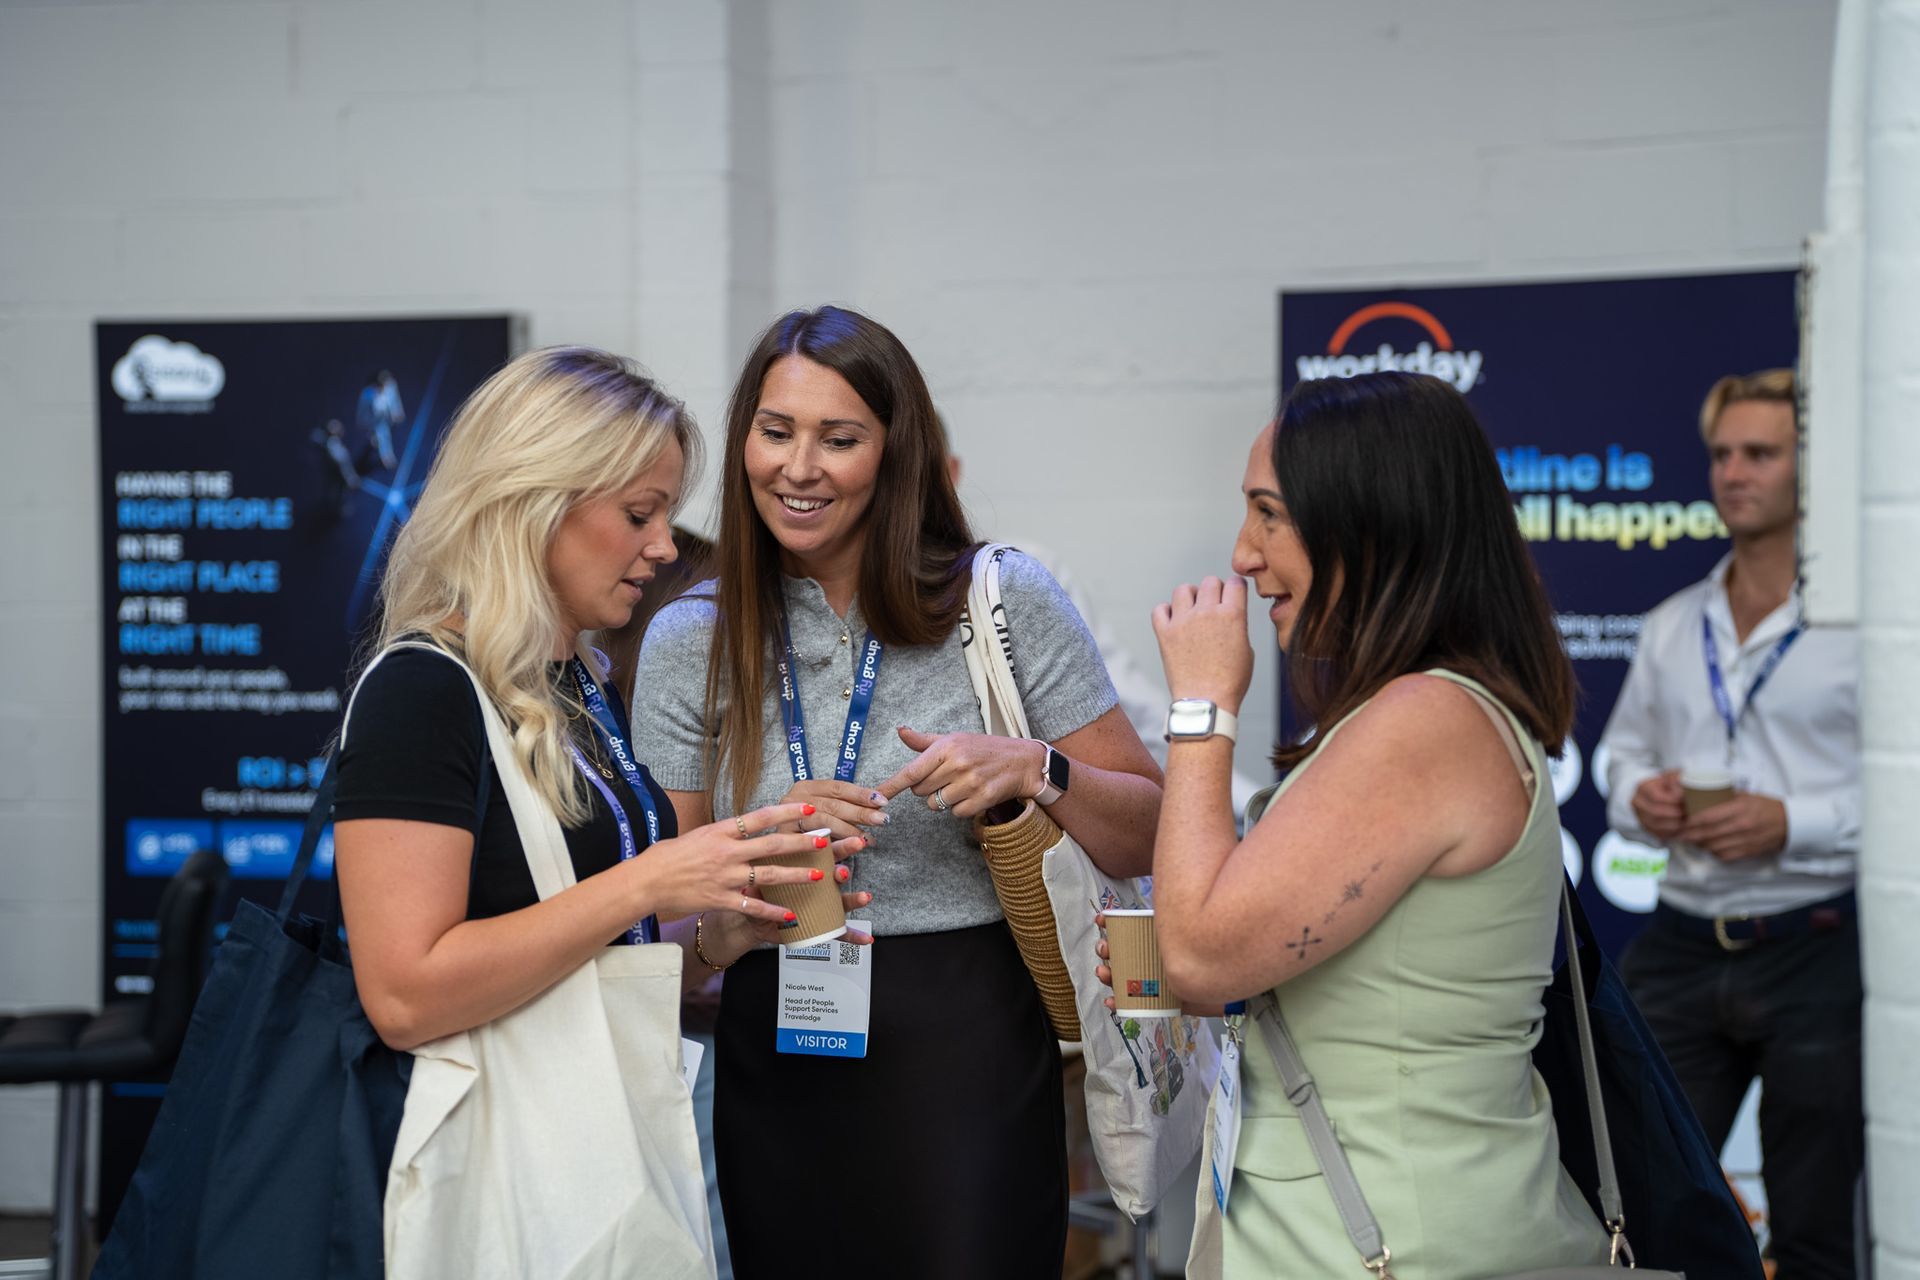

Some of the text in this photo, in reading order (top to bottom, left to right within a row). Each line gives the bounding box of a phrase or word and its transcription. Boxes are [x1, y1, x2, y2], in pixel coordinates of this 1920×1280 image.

[1296, 342, 1483, 394] workday
[1606, 443, 1653, 491] is
[193, 471, 232, 497] THE
[117, 498, 293, 529] RIGHT PEOPLE
[1555, 494, 1730, 550] happe
[117, 534, 184, 561] IN THE
[118, 560, 280, 592] RIGHT PLACE
[118, 596, 188, 624] AT THE
[119, 623, 261, 655] RIGHT TIME
[788, 725, 808, 780] mygroup
[837, 721, 863, 777] mygroup
[784, 1013, 821, 1022] Travelodge
[785, 997, 803, 1005] Head
[812, 999, 834, 1007] People
[785, 1004, 838, 1014] Support Services
[795, 1034, 847, 1050] VISITOR
